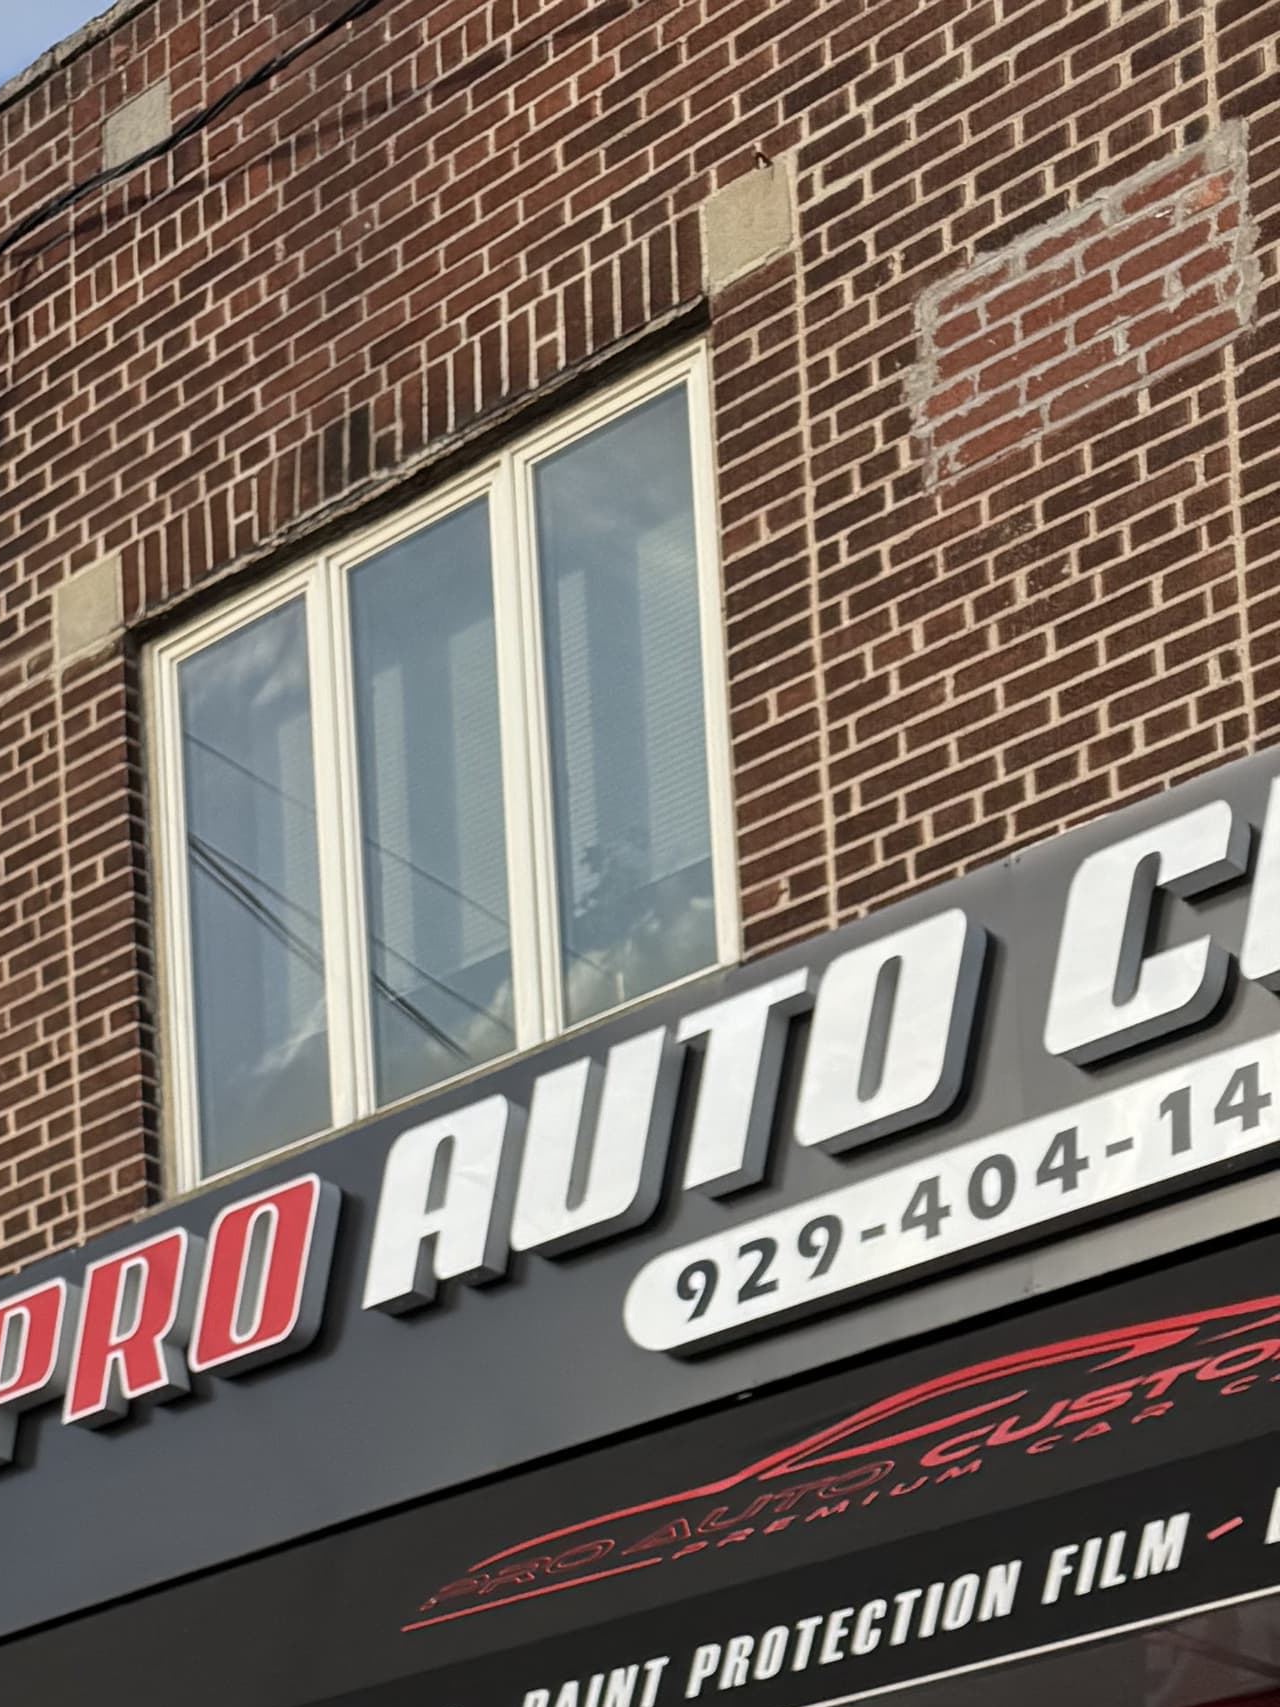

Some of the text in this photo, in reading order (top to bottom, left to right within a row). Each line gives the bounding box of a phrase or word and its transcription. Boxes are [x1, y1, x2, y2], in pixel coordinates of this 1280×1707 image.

[362, 907, 983, 1314] AUTO
[1044, 774, 1280, 1060] C
[671, 1458, 982, 1560] PREMIUM
[1026, 1399, 1175, 1455] CAR
[920, 1338, 1280, 1467] CUSTO
[685, 1559, 1023, 1699] PROTECTION
[1040, 1511, 1192, 1605] FILM
